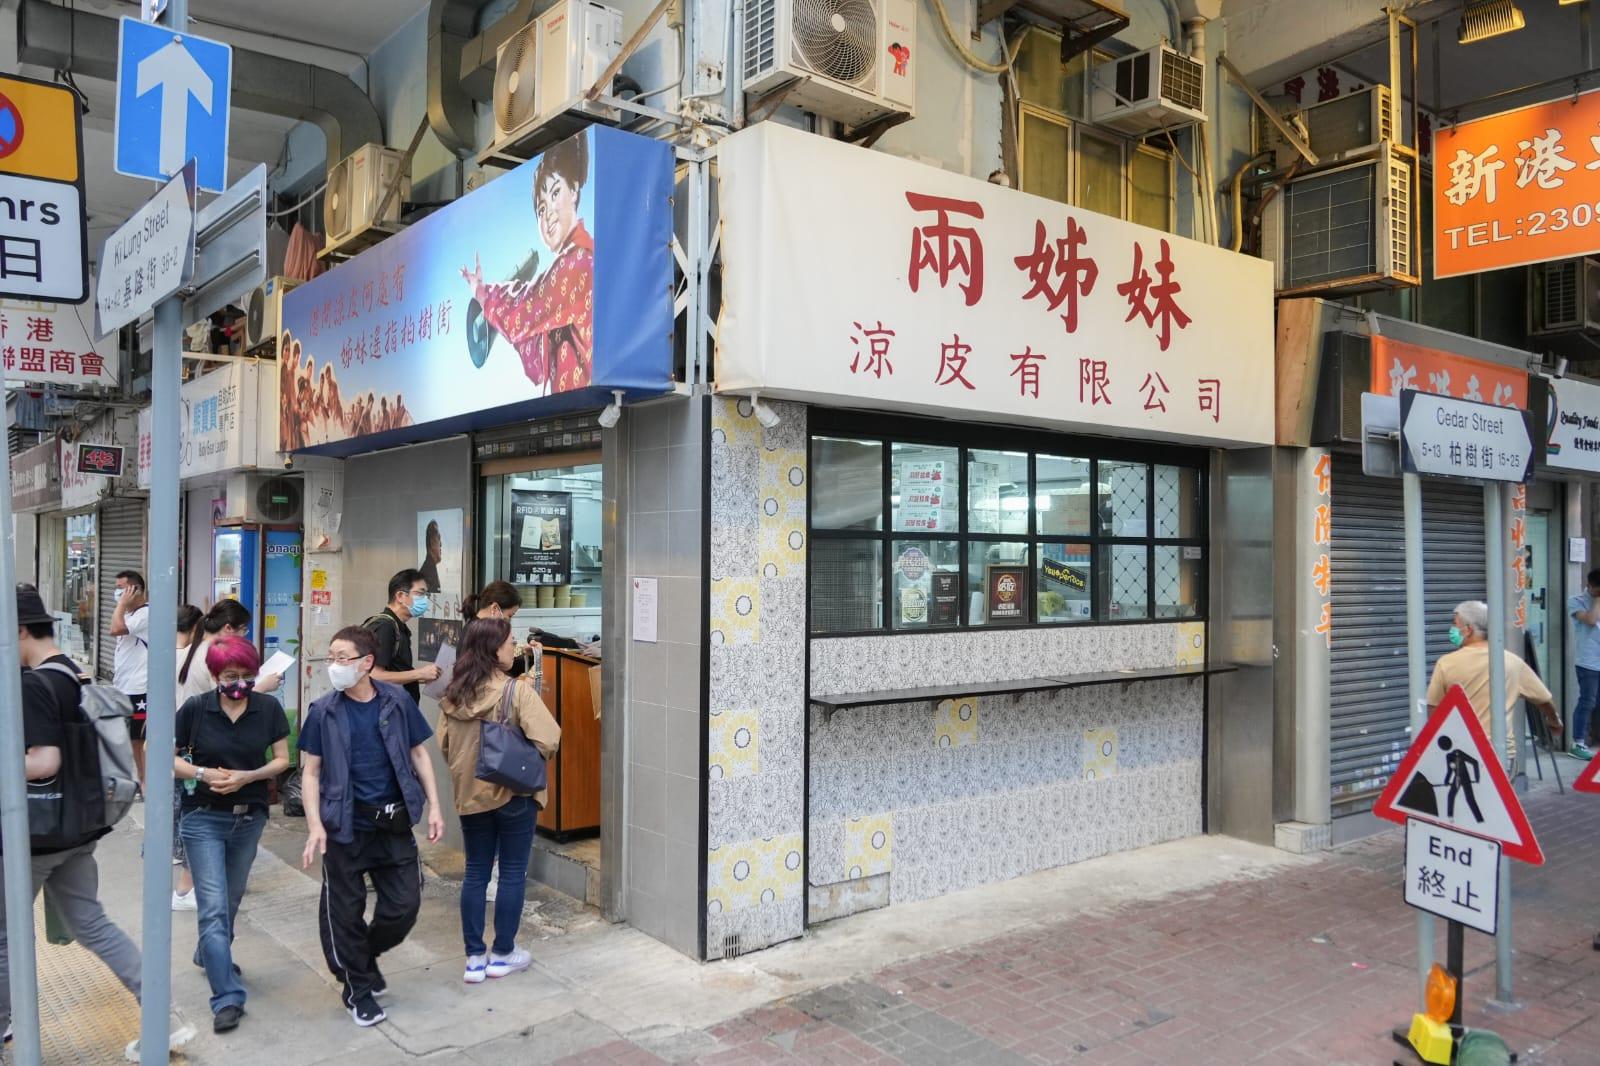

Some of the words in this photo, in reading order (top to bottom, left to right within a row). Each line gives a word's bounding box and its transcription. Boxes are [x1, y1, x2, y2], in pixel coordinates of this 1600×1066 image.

[1443, 121, 1600, 206] 新港
[114, 241, 122, 268] Ki
[123, 230, 142, 260] Lung
[144, 200, 169, 242] Street
[123, 257, 157, 309] 基隆街
[904, 190, 1193, 352] 兩姊妹
[849, 319, 1221, 424] 涼皮有限公司
[1436, 406, 1469, 430] Cedar
[1472, 412, 1504, 435] Street
[1449, 440, 1493, 470] 柏樹街
[516, 505, 533, 514] RFID
[1429, 835, 1472, 867] End
[1417, 865, 1482, 914] 終止
